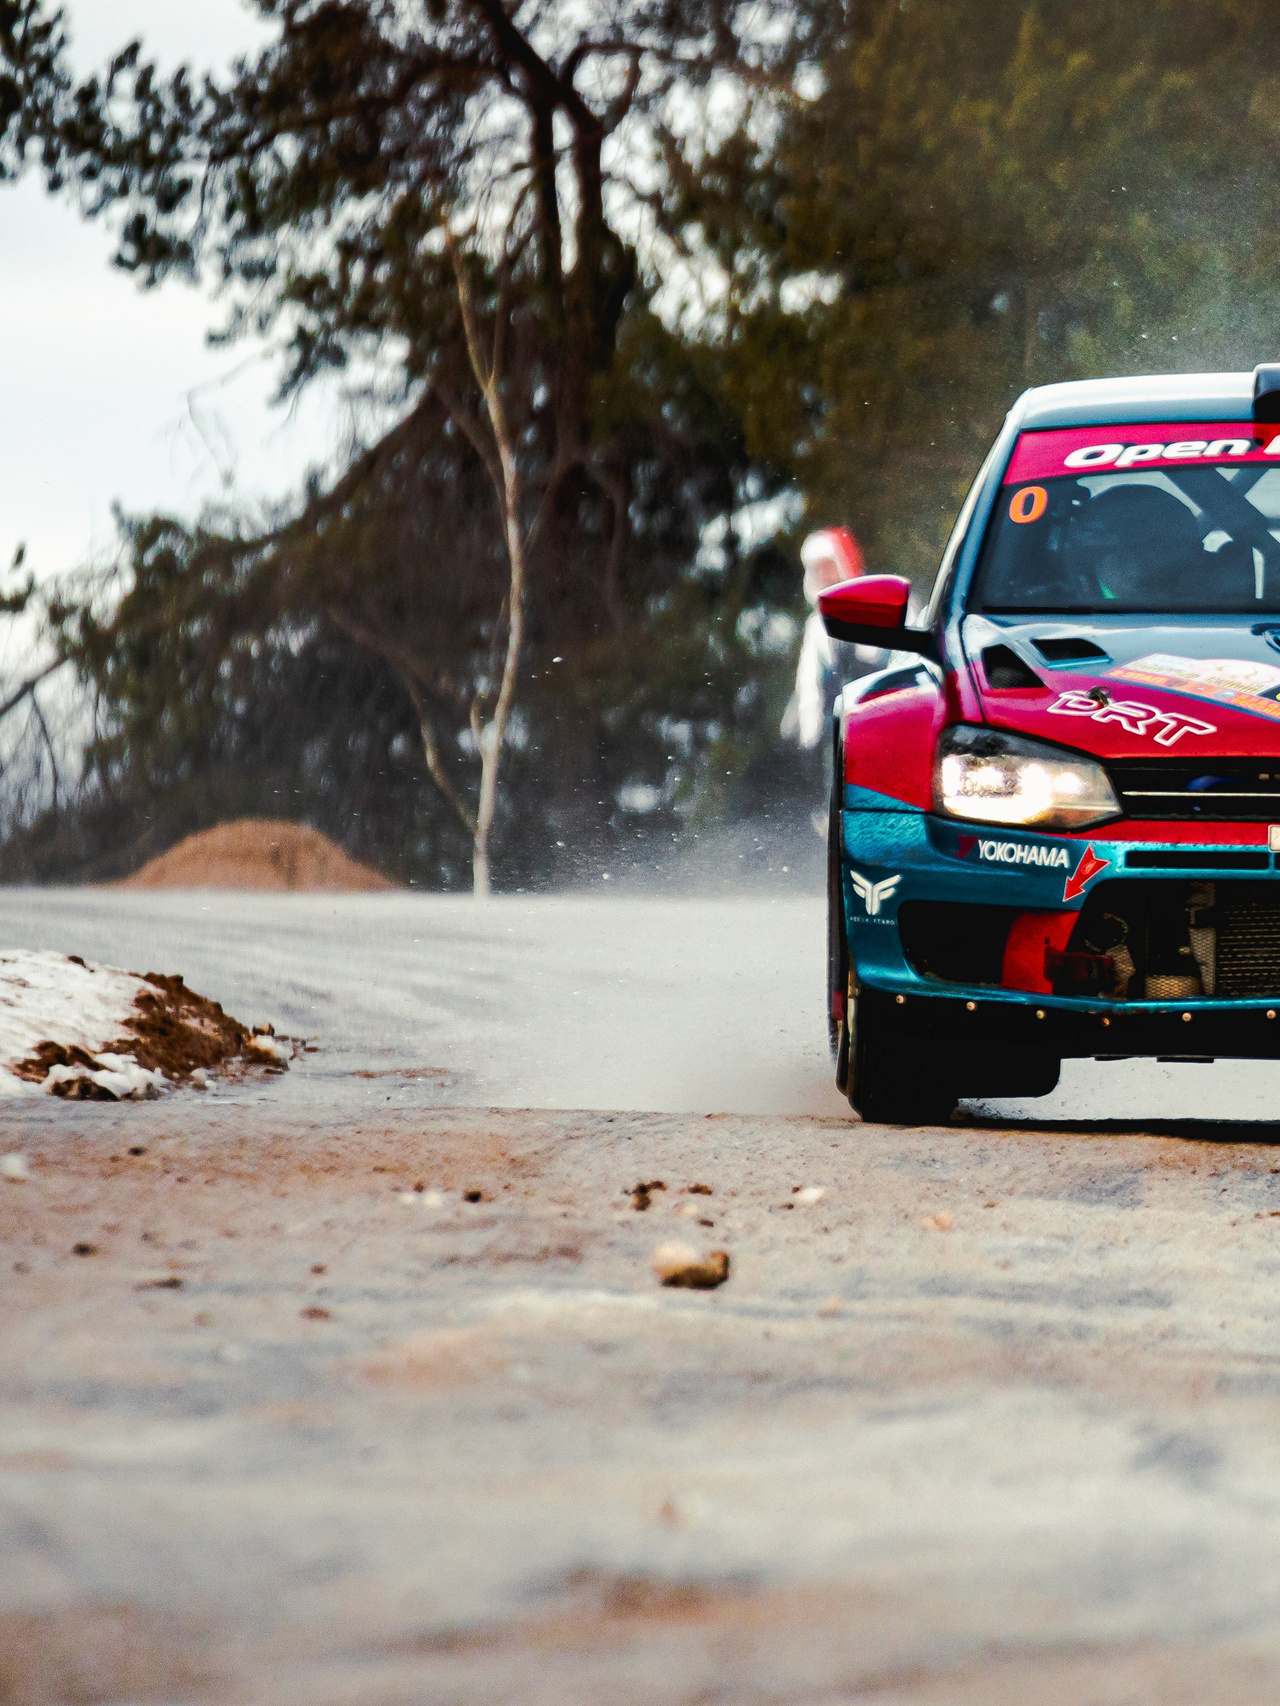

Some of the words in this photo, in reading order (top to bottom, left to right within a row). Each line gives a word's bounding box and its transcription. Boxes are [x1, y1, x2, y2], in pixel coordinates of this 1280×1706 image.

[1063, 438, 1251, 468] Open
[1009, 486, 1048, 524] 0
[1046, 690, 1218, 747] DRT
[978, 839, 1070, 869] YOKOHAMA
